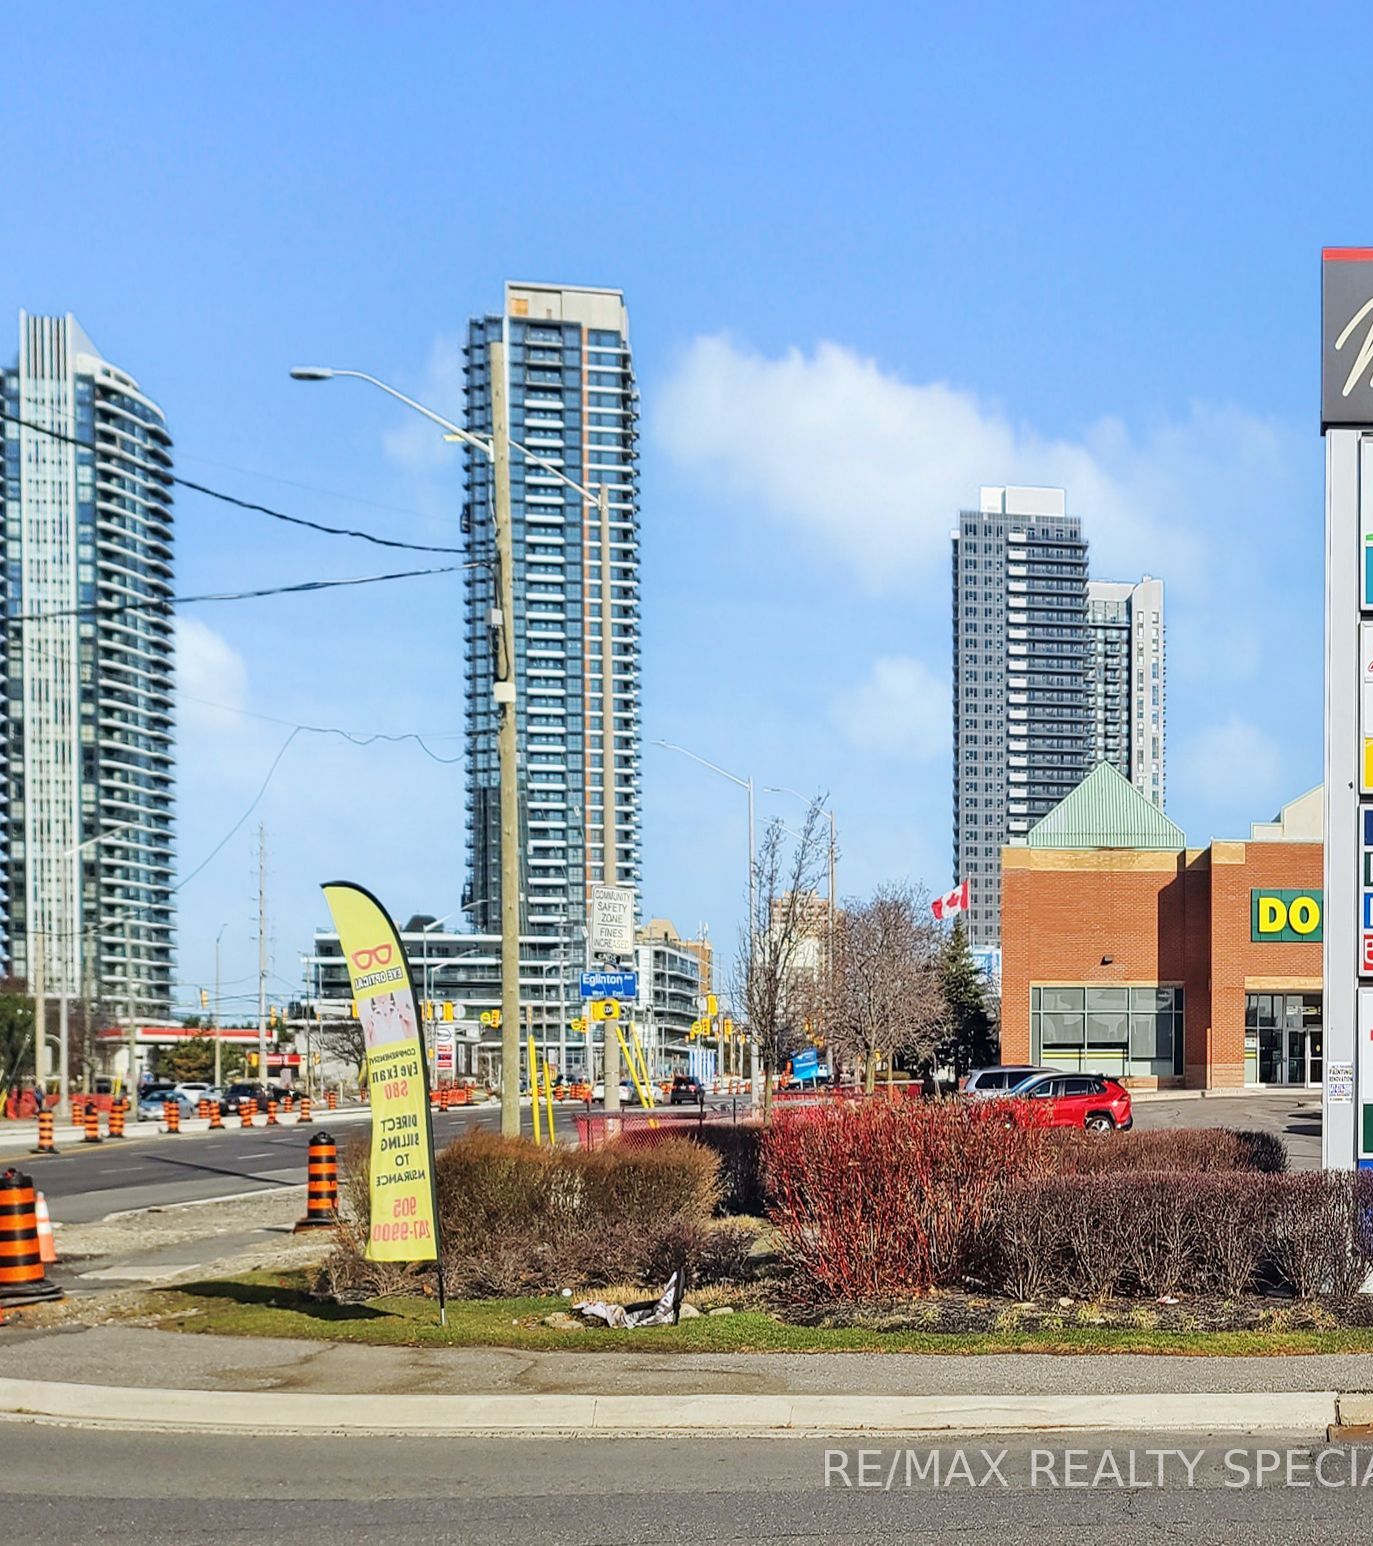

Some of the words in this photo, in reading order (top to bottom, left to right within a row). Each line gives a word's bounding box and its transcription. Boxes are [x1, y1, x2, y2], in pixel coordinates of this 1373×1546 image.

[595, 889, 630, 902] COMMUNITY
[597, 901, 628, 913] SAFETY
[601, 913, 623, 924] ZONE
[600, 928, 624, 939] FINES
[594, 940, 630, 950] INCREASED
[582, 973, 623, 986] Eglinton
